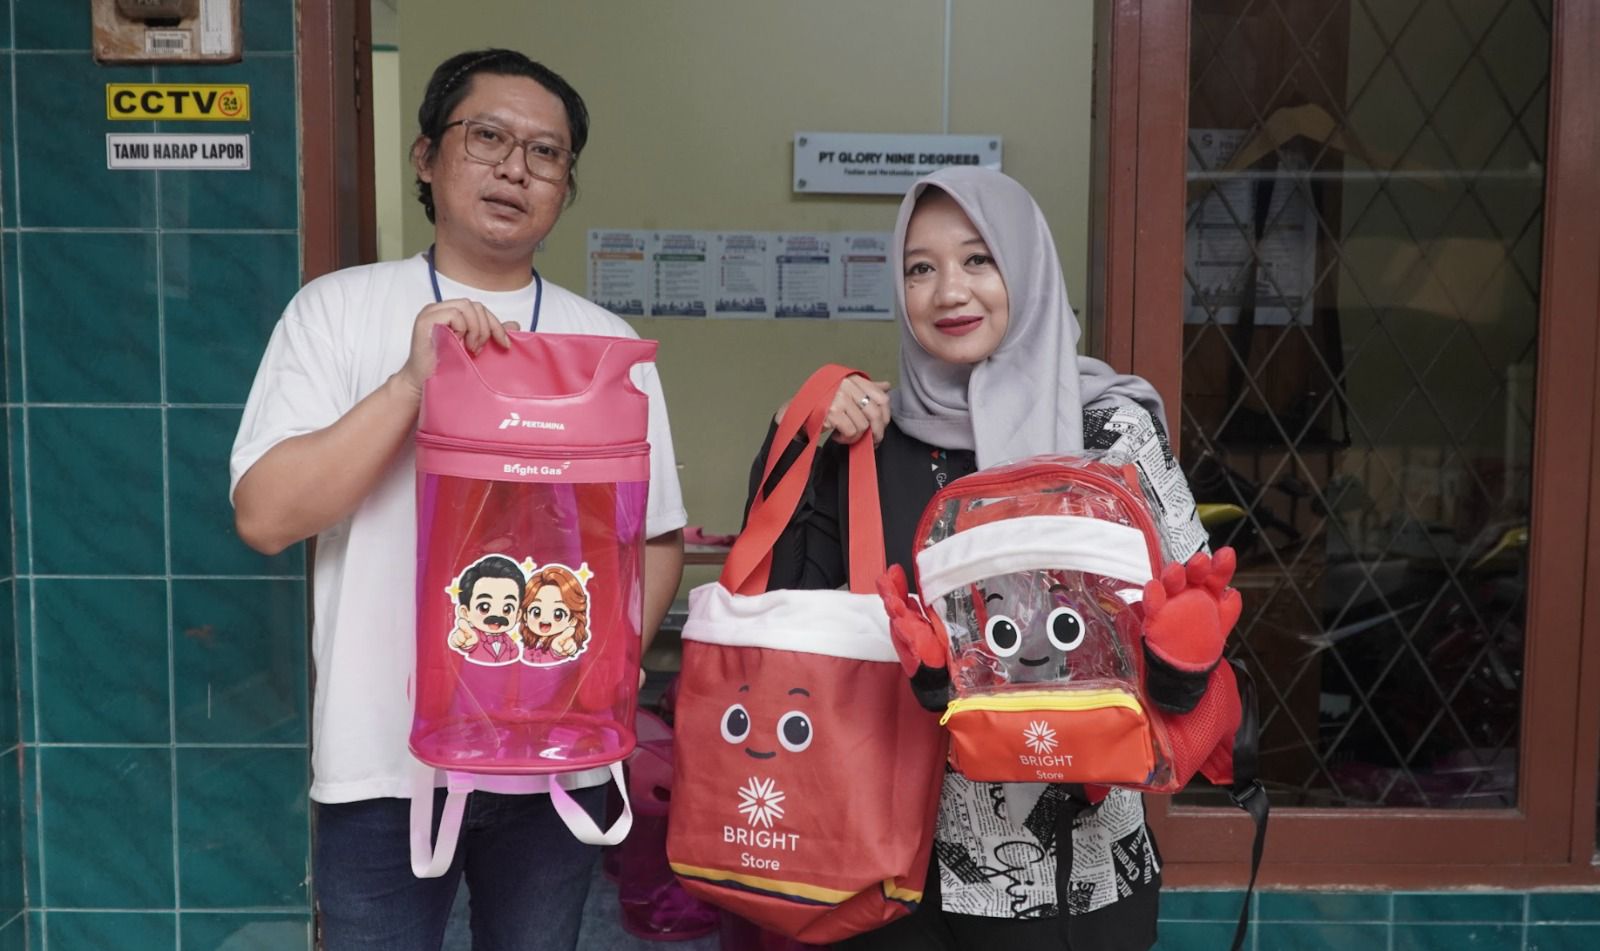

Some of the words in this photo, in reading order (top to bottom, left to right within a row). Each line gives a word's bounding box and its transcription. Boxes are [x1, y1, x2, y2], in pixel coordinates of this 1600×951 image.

[113, 90, 217, 114] CCTV
[223, 97, 237, 106] 24
[113, 144, 149, 159] TAMU
[153, 144, 198, 159] HARAP
[202, 144, 244, 159] LAPOR
[819, 152, 835, 163] PT
[838, 152, 882, 164] GLORY
[886, 153, 915, 165] NINE
[919, 154, 980, 165] DEGREES
[522, 420, 565, 430] PERTAMINA
[503, 464, 538, 476] Bright
[540, 466, 562, 475] Gas
[1019, 755, 1073, 767] BRIGHT
[1036, 770, 1064, 779] Store
[723, 825, 800, 851] BRIGHT
[741, 852, 780, 870] Store
